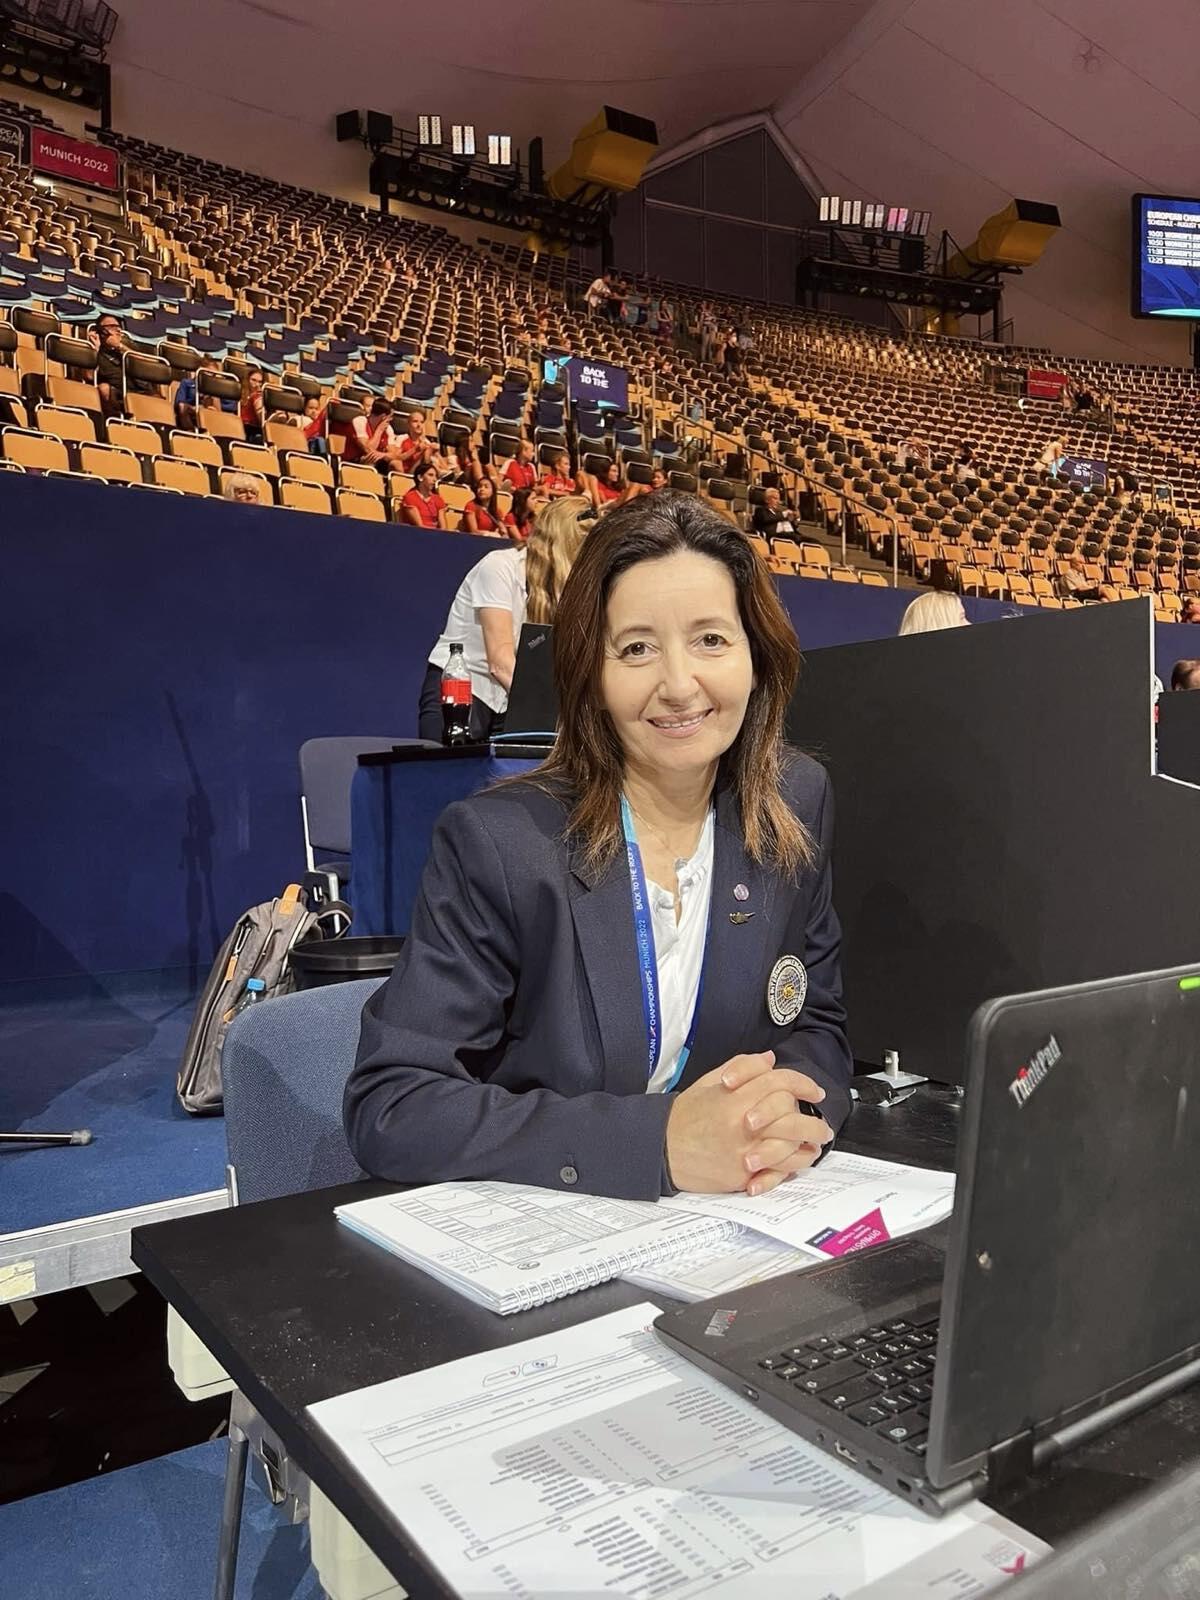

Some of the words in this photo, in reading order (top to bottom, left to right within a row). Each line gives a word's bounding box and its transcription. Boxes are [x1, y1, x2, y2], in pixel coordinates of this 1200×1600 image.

[40, 144, 81, 164] MUNICH
[83, 157, 109, 172] 2022
[580, 374, 592, 384] TO
[592, 377, 609, 389] THE
[583, 366, 606, 379] BACK
[630, 868, 638, 880] THE
[632, 881, 640, 890] TO
[634, 892, 644, 910] BACK
[638, 919, 649, 938] 2022
[640, 940, 652, 969] MUNICH
[645, 970, 656, 1026] CHAMPIONSHIPS
[1009, 1034, 1061, 1109] ThinkPad
